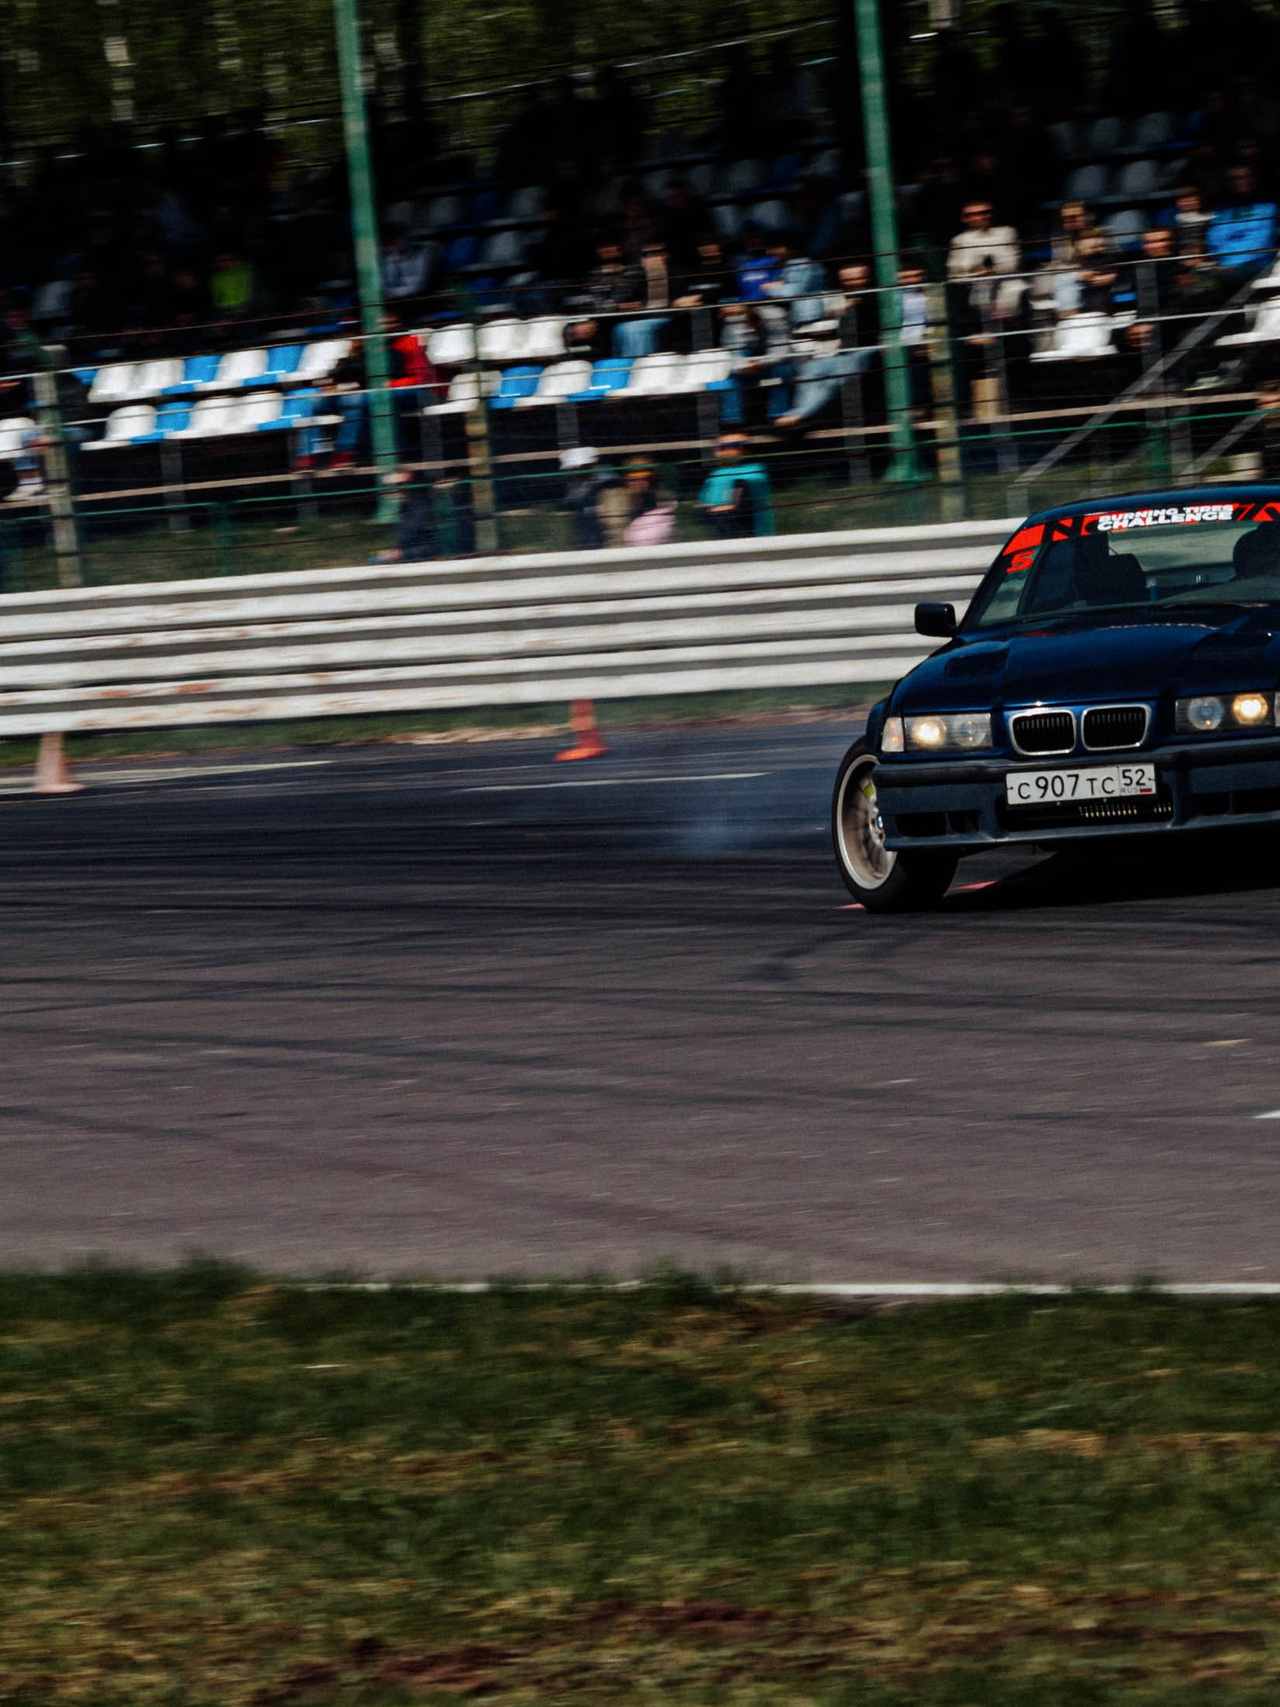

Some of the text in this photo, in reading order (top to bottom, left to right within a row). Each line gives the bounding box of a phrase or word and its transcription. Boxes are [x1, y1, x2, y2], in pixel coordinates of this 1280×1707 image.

[1097, 510, 1233, 532] CHALLENGE
[1098, 507, 1179, 523] BURNING
[1183, 504, 1234, 514] TIRES
[1005, 550, 1035, 573] 5
[1121, 769, 1146, 786] 52
[1120, 786, 1139, 795] RUS
